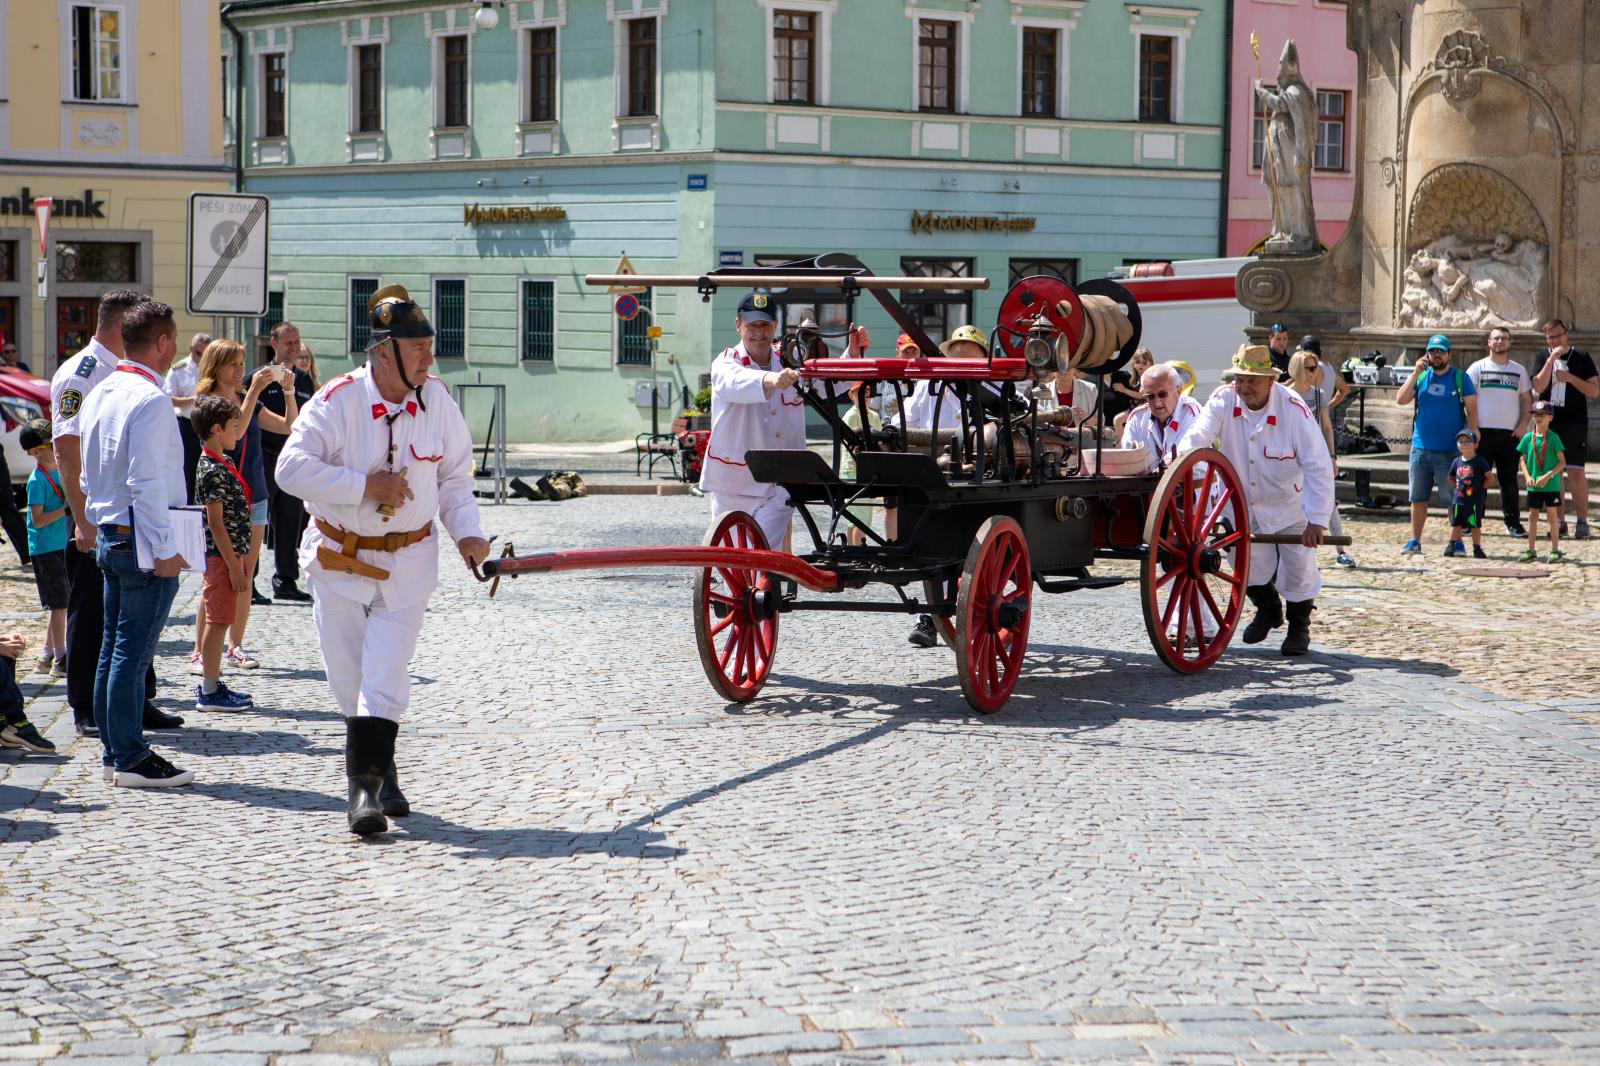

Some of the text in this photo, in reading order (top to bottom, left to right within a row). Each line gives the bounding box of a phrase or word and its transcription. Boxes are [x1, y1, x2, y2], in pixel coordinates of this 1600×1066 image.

[200, 200, 225, 213] PĚŠÍ
[479, 206, 534, 224] MONETA
[937, 215, 1003, 232] MONETA
